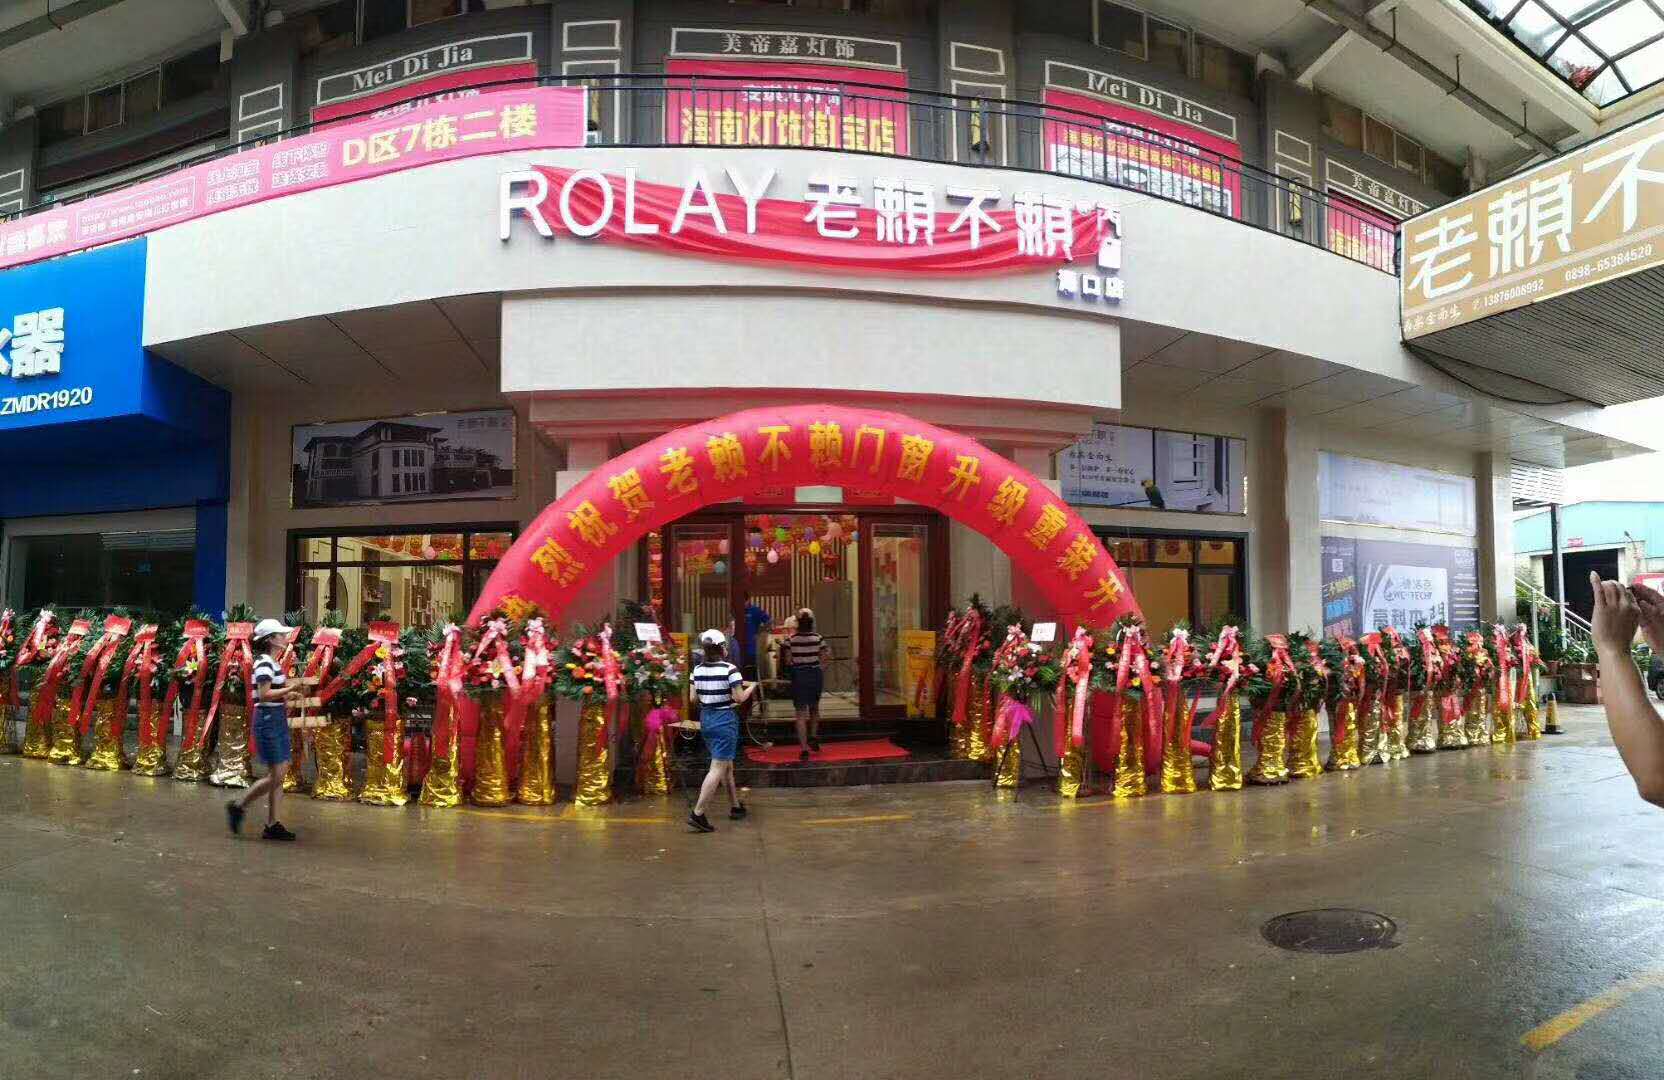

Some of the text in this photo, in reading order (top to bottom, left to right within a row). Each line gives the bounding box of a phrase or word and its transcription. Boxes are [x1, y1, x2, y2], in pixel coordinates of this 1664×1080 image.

[352, 46, 473, 92] Mei Di Jia
[720, 33, 856, 58] 美帝嘉灯饰
[1087, 73, 1203, 122] Mei Di Jia
[342, 103, 538, 167] D区7栋二楼
[499, 166, 777, 241] ROLAY
